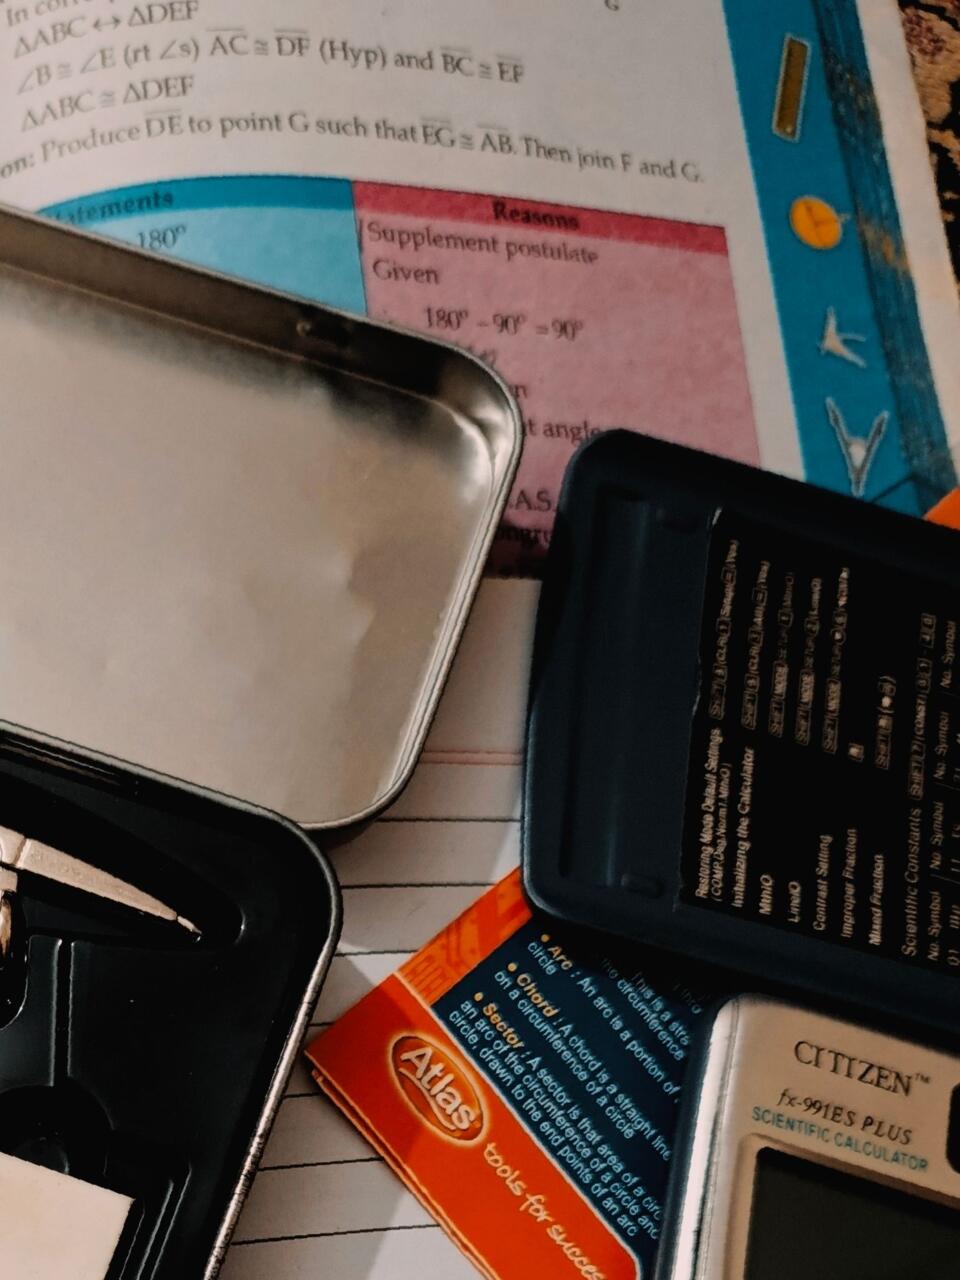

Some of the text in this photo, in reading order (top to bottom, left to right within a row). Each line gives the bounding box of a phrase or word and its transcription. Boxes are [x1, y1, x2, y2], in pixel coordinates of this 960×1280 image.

[319, 38, 388, 71] (Hyp)
[394, 50, 434, 71] and
[41, 112, 677, 180] Produce to point such that Then join and
[367, 221, 598, 264] Supplement postulate
[493, 200, 580, 231] Reasons
[373, 260, 439, 285] Given
[527, 941, 558, 976] circle
[547, 945, 573, 971] Arc
[624, 1039, 665, 1082] portion
[617, 979, 685, 1061] circumference
[482, 1002, 625, 1174] Sector sector that area
[516, 973, 561, 1018] Chord
[568, 1035, 603, 1072] chord
[614, 1093, 657, 1140] straight
[517, 992, 637, 1139] circumference of circle
[401, 1046, 477, 1131] Atlas
[484, 1143, 527, 1196] tools
[519, 1195, 553, 1224] for
[460, 1000, 640, 1216] an arc the circumference circle
[479, 1047, 515, 1087] drawn
[510, 1083, 526, 1101] to
[522, 1097, 543, 1122] the
[539, 1121, 566, 1147] end
[556, 1144, 593, 1184] points
[616, 1214, 638, 1237] arc
[751, 1106, 929, 1172] SCIENTIFIC CALCULATOR
[777, 1088, 913, 1147] fx-991ES PLUS
